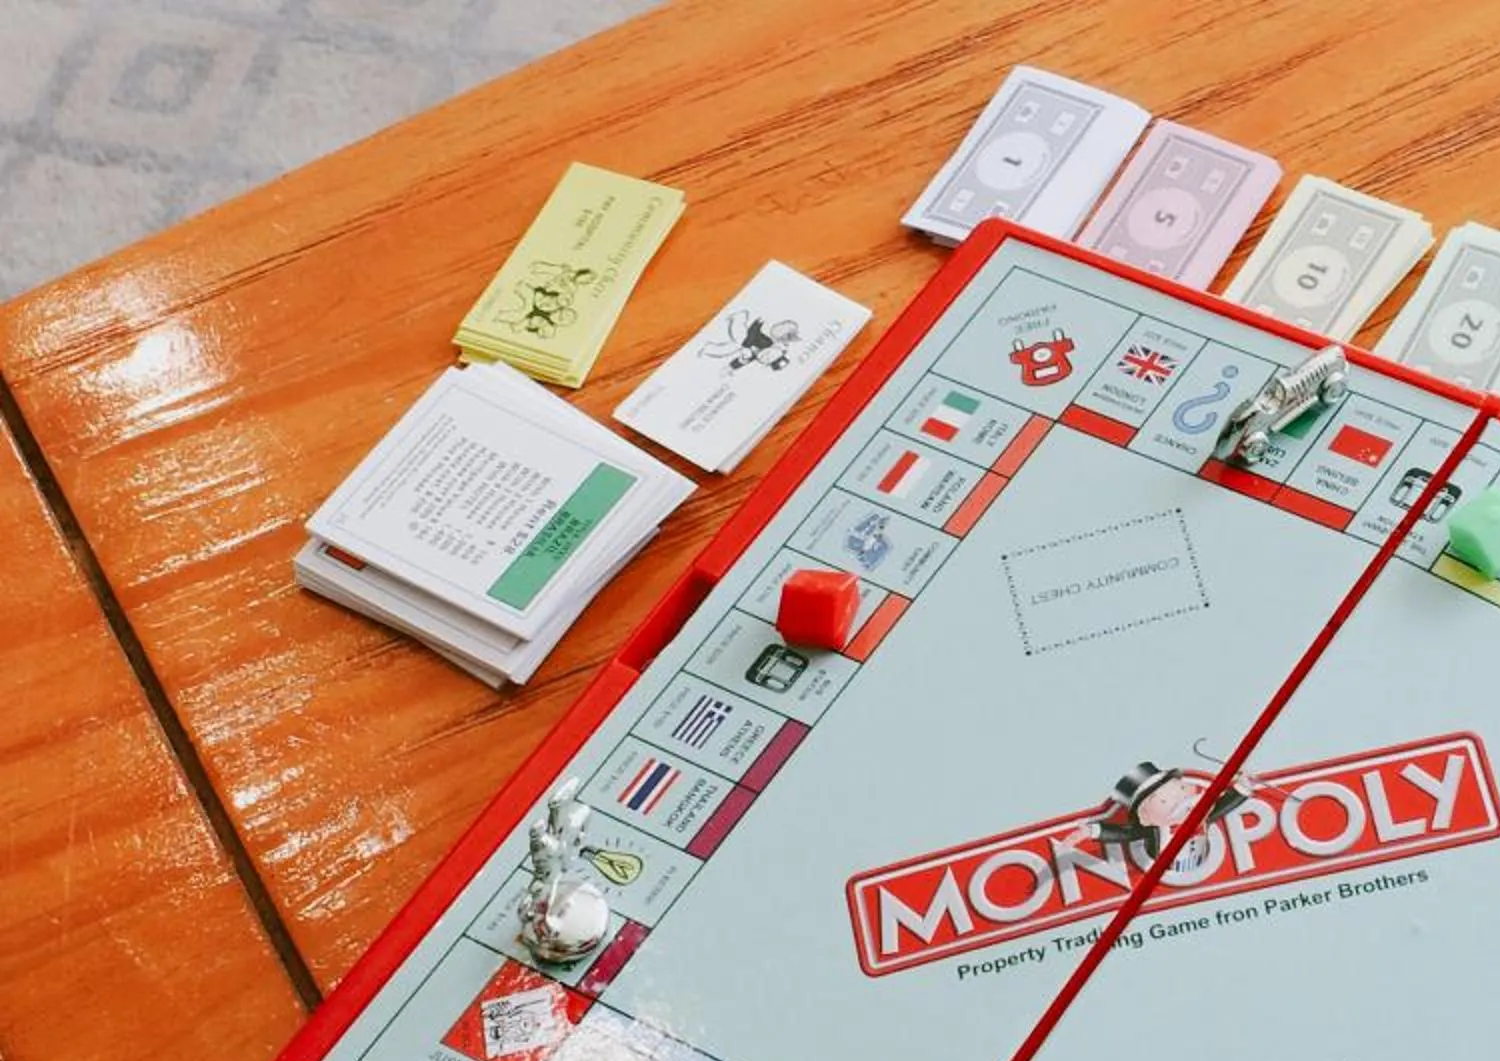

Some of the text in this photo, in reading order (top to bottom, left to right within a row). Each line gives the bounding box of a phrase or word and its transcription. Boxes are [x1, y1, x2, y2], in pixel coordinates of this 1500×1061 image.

[1003, 155, 1023, 169] 1
[1154, 210, 1176, 228] 5
[1297, 262, 1328, 290] 10
[1449, 313, 1482, 349] 20
[1152, 429, 1197, 459] CHANCE
[1314, 473, 1350, 498] CHINA
[525, 497, 556, 531] Rent
[1029, 556, 1180, 605] COMMUNITY CHEST
[718, 716, 753, 762] ATHENS
[729, 720, 765, 768] GREECE
[662, 773, 707, 833] BANGKOK
[674, 778, 719, 839] THAILAND
[878, 753, 1468, 956] MONOPOLY
[956, 944, 1046, 980] Property
[1149, 914, 1210, 940] Game
[1215, 906, 1259, 926] fron
[1264, 890, 1333, 914] Parker
[1337, 867, 1430, 899] Brothers
